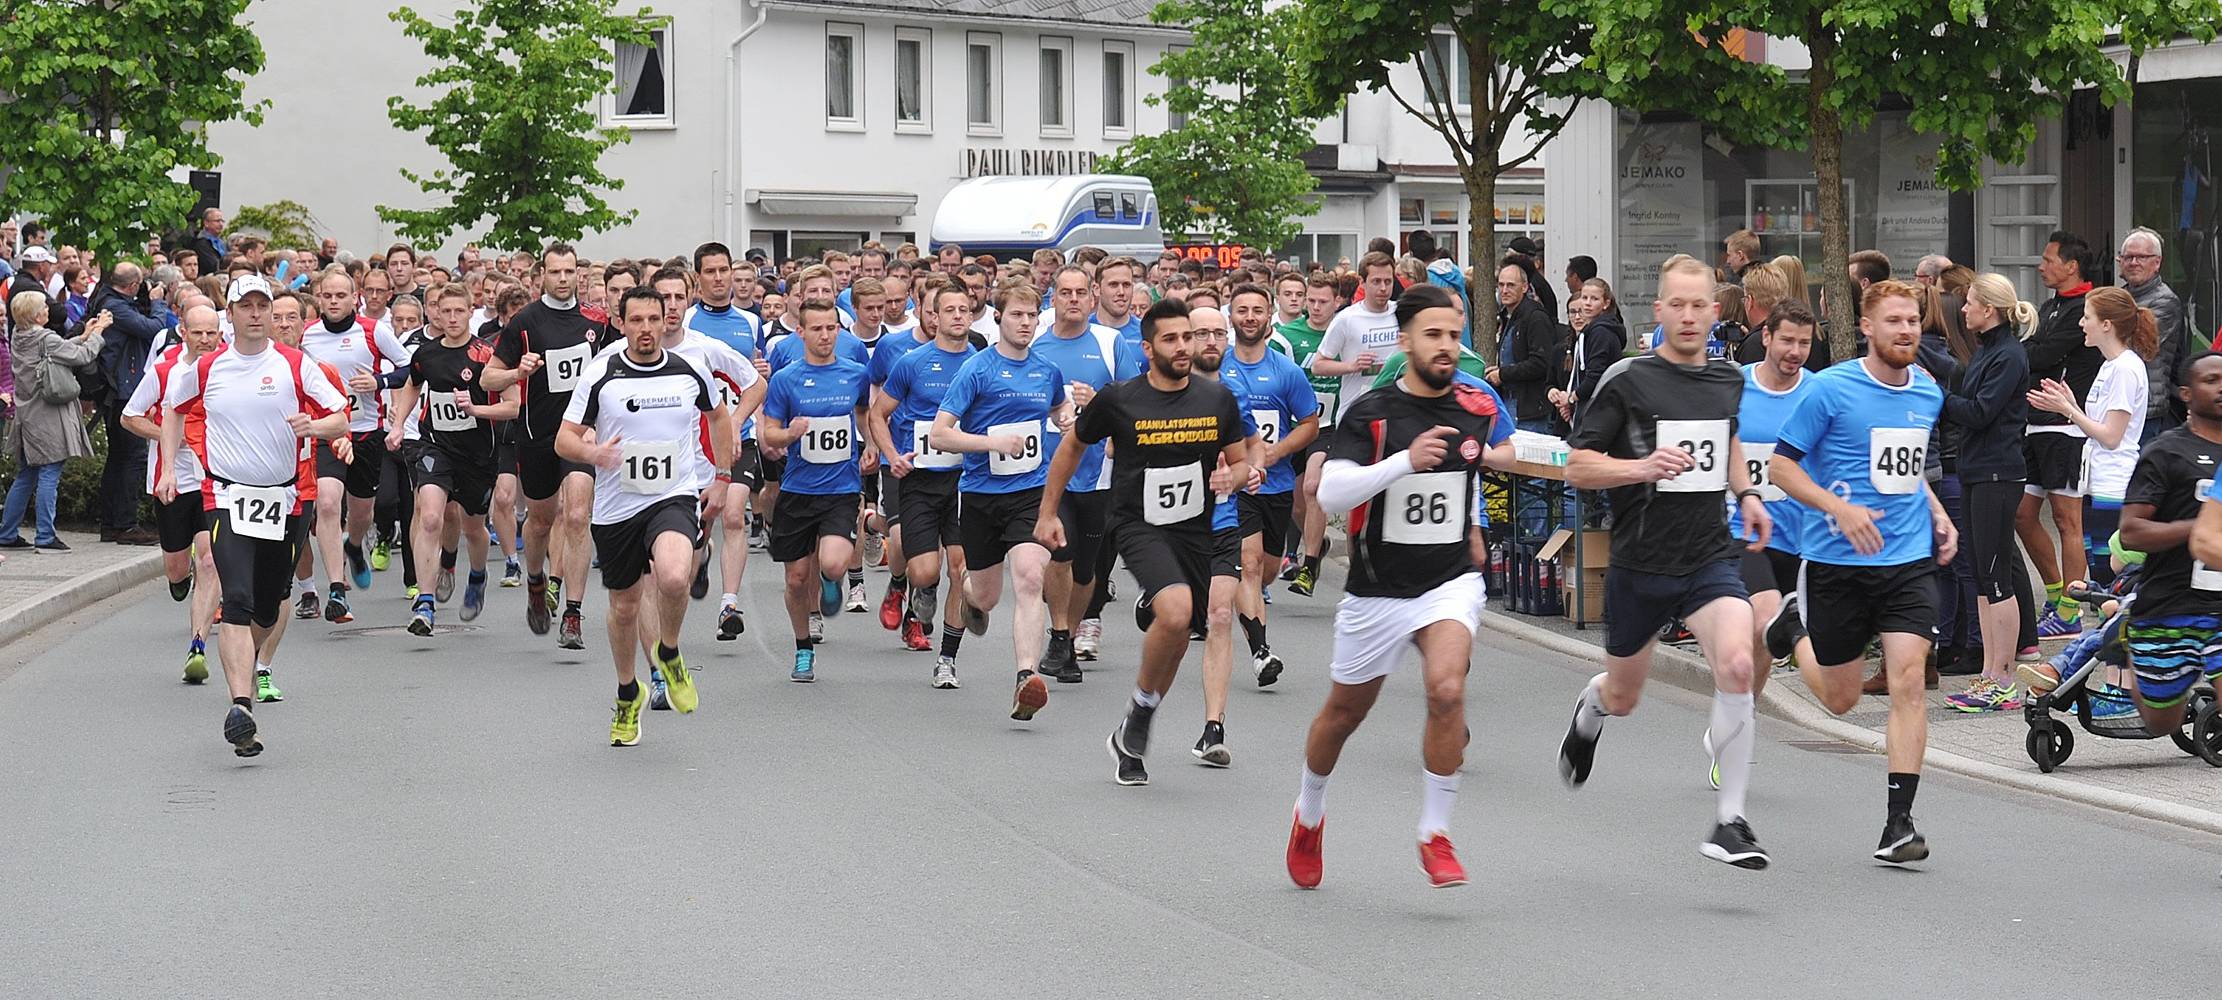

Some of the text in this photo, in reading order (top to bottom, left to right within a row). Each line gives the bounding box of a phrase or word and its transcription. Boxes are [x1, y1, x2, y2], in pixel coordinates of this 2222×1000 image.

[967, 149, 1013, 177] PAUL
[1621, 166, 1686, 178] JEMAKO
[558, 357, 583, 379] 97
[806, 429, 848, 451] 168
[625, 455, 672, 480] 161
[1877, 446, 1923, 476] 486
[1159, 480, 1193, 509] 57
[1406, 492, 1446, 525] 86
[234, 497, 281, 525] 124
